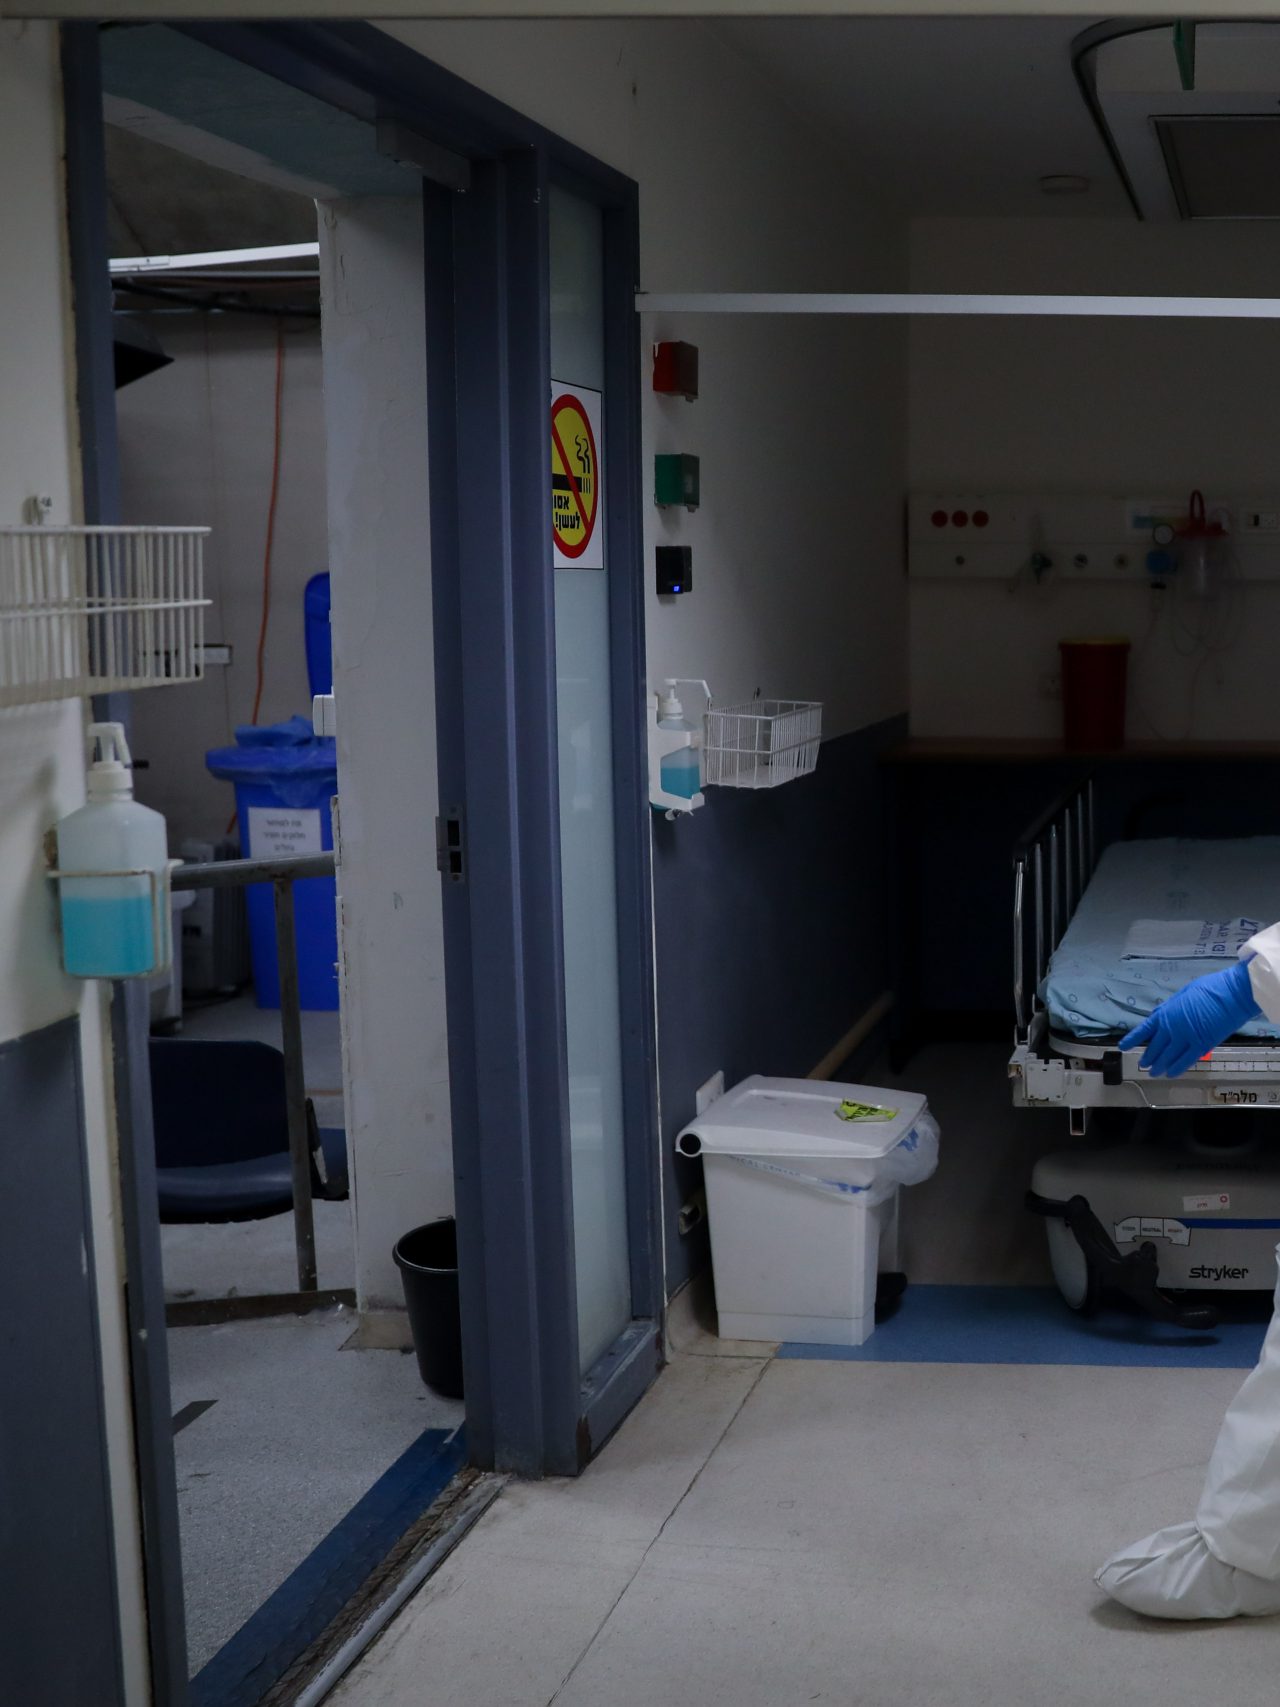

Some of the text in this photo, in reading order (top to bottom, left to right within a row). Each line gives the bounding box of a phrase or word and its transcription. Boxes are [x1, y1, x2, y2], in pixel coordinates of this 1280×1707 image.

[553, 495, 570, 510] אסו
[555, 511, 580, 531] לעשן!
[1188, 1264, 1249, 1281] stryker
